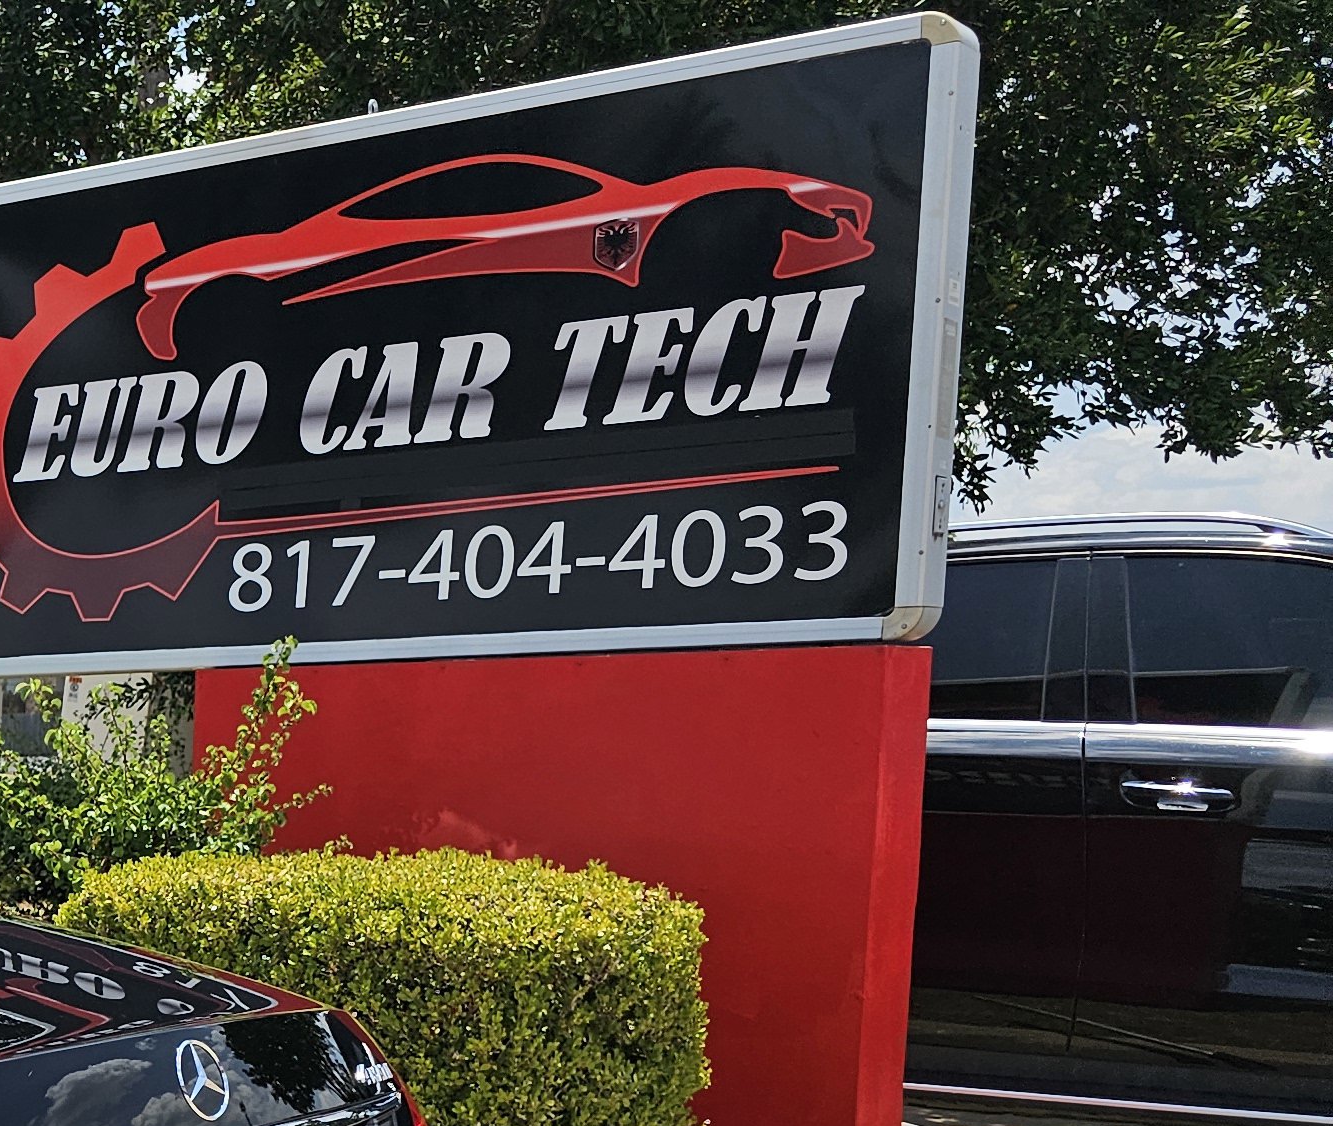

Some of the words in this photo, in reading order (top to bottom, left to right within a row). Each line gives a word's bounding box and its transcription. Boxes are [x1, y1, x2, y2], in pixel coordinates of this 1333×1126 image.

[13, 361, 268, 483] EURO
[300, 332, 511, 455] CAR
[544, 284, 865, 432] TECH
[228, 500, 849, 613] 817-404-4033
